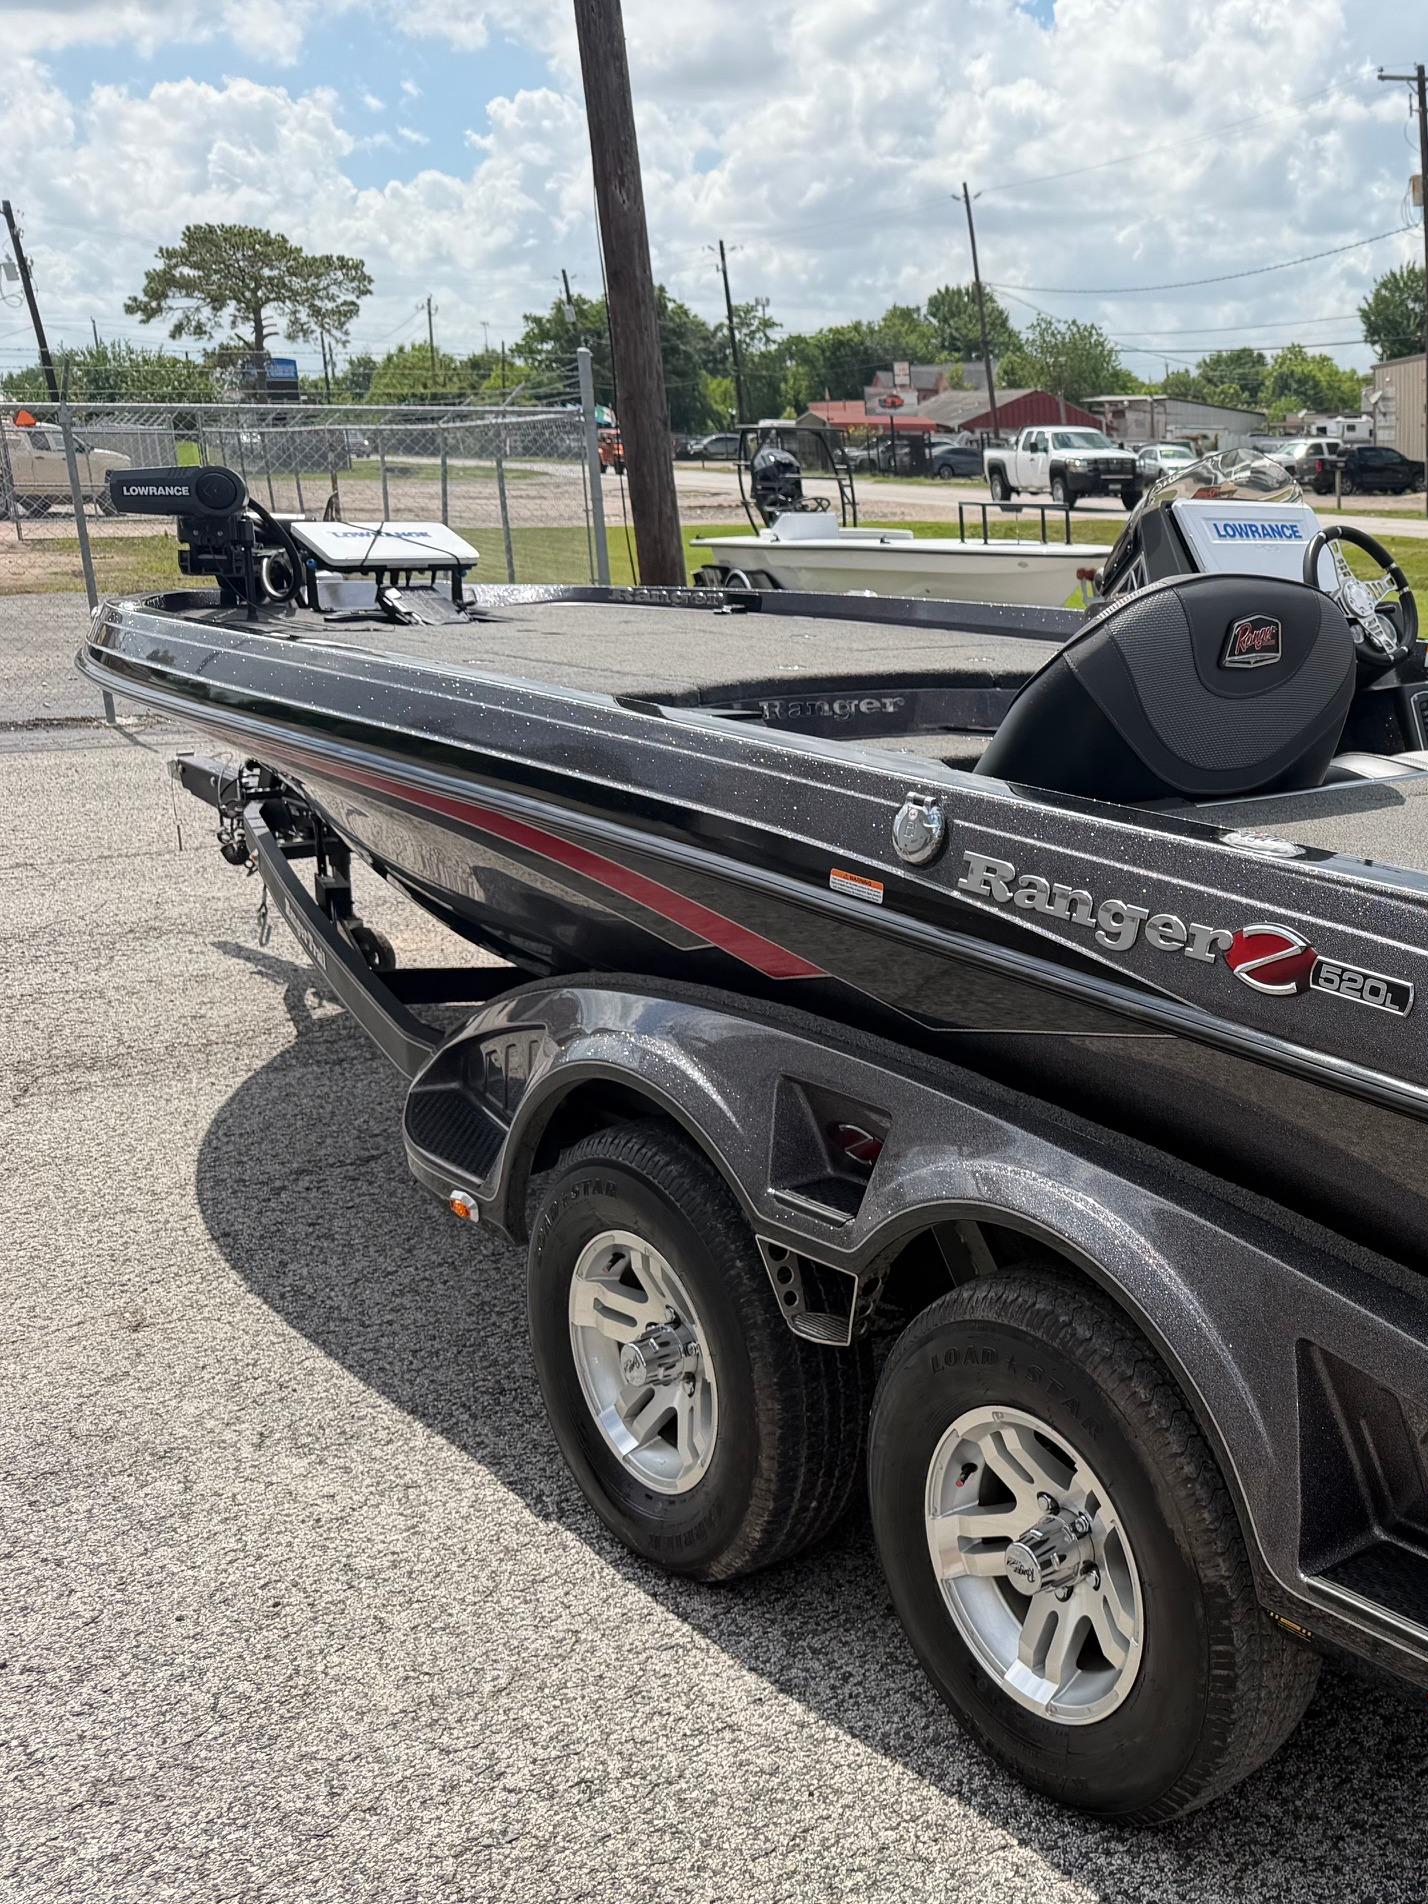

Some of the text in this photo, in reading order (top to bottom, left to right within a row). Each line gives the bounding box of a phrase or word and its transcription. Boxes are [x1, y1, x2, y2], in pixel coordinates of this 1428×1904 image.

[122, 486, 190, 496] LOWRANCE
[1213, 522, 1303, 539] LOWRANCE
[1234, 622, 1277, 655] Ranger
[758, 697, 905, 721] Ranger
[957, 850, 1234, 964] Ranger
[930, 1345, 1099, 1441] LOAD STAR
